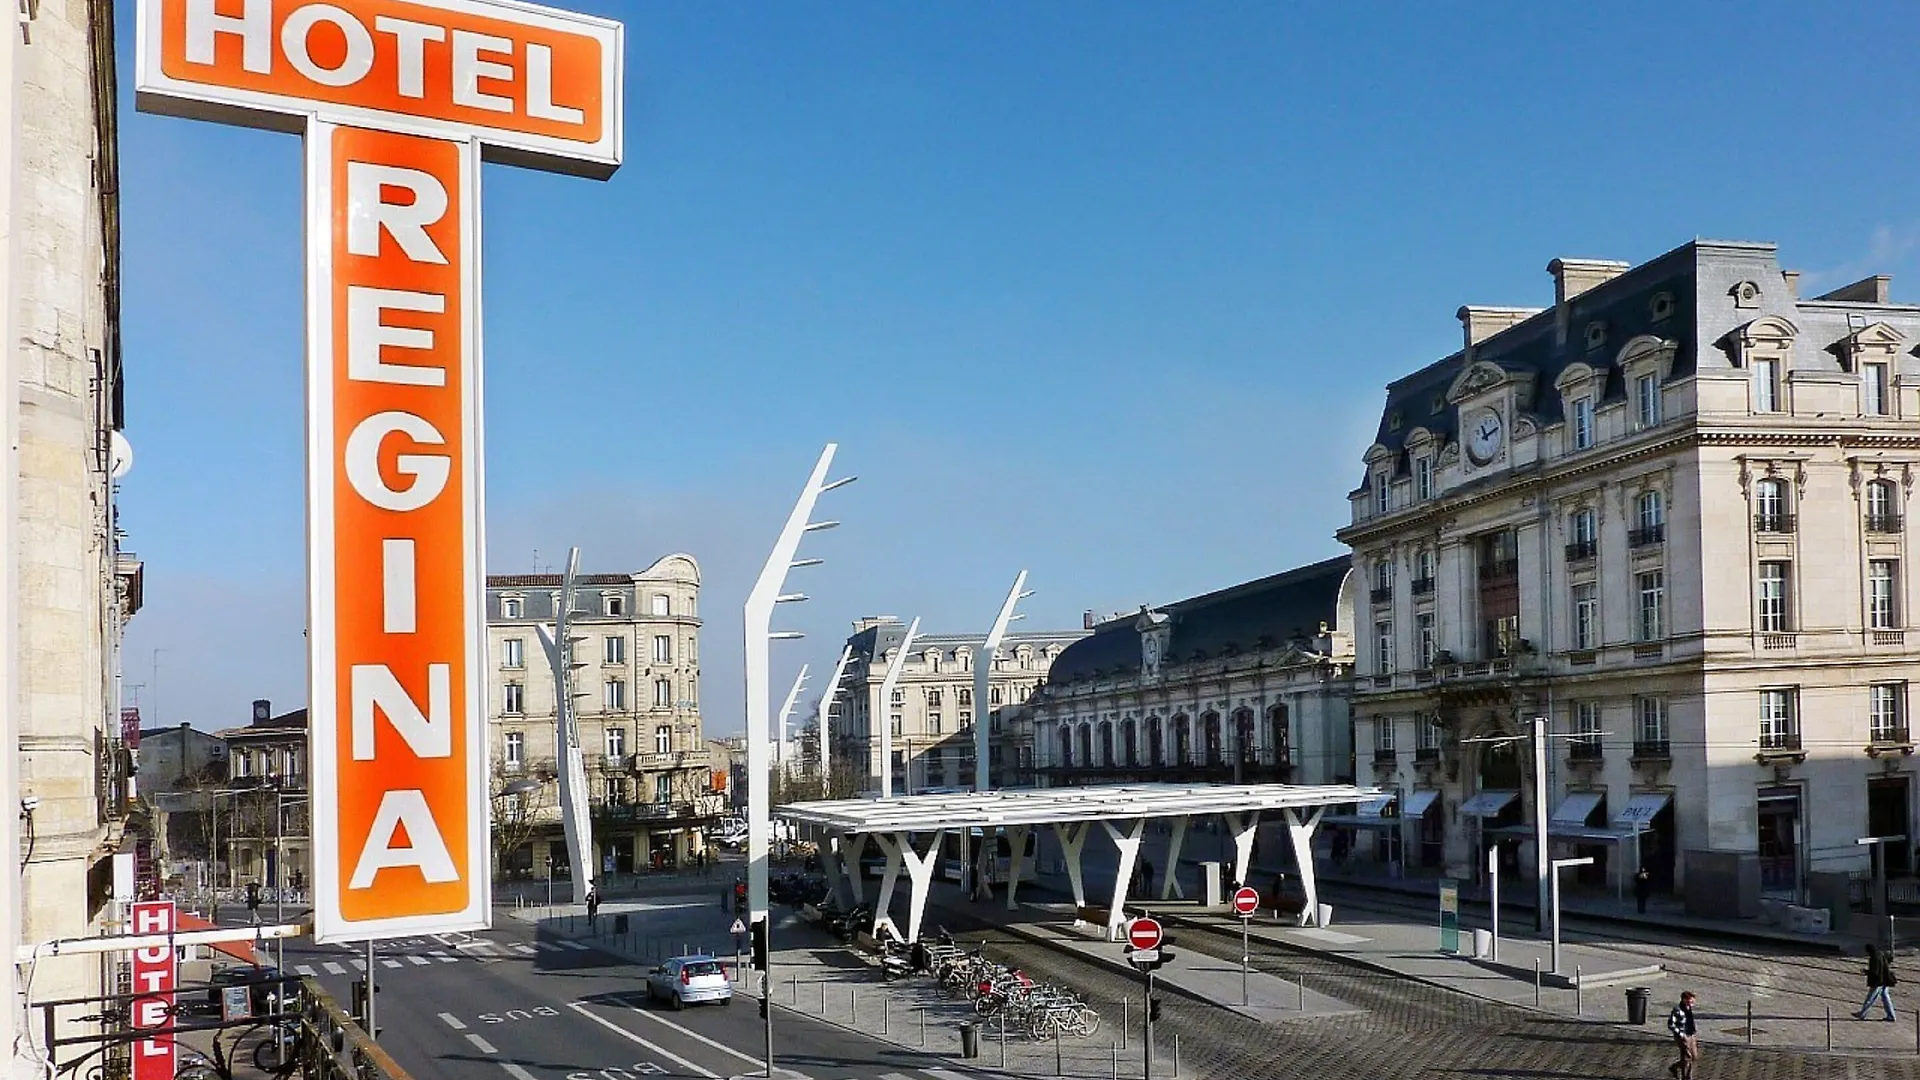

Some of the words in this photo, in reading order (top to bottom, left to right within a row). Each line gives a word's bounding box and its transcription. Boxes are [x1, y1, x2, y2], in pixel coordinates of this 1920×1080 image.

[185, 0, 584, 126] HOTEL
[344, 160, 461, 889] REGINA
[478, 1006, 559, 1024] BUS
